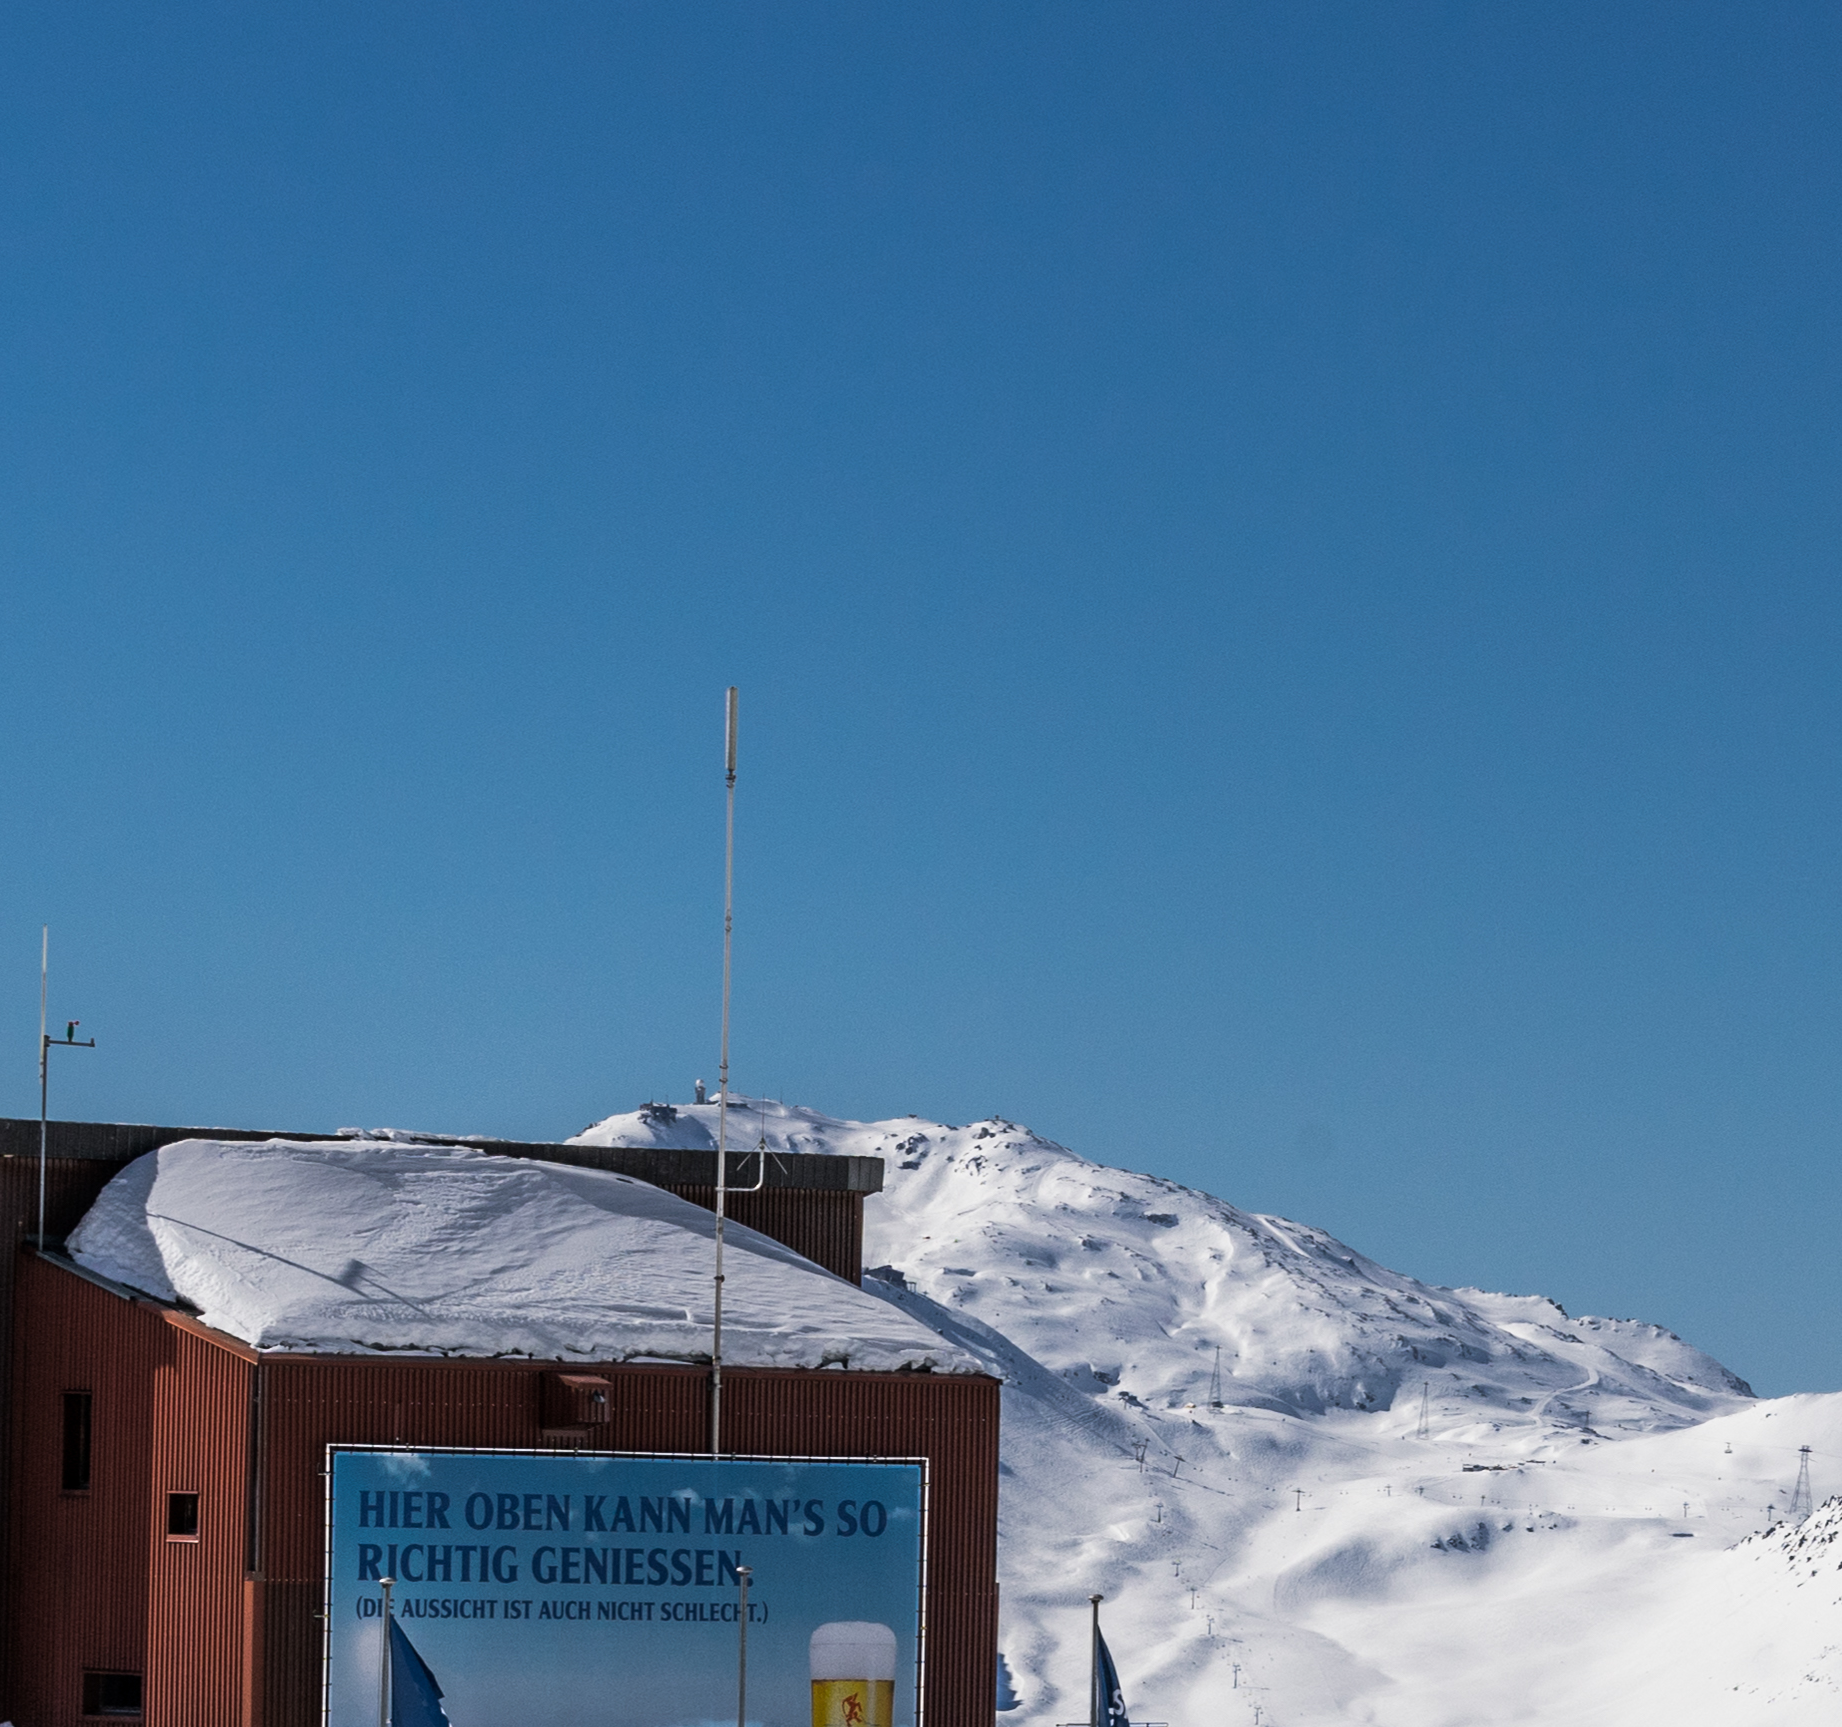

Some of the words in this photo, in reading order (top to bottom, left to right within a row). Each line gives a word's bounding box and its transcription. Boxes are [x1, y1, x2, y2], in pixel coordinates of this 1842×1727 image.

[358, 1489, 452, 1529] HIER
[464, 1491, 570, 1531] OBEN
[584, 1494, 692, 1534] KANN
[704, 1497, 825, 1537] MAN'S
[837, 1499, 888, 1538] SO
[357, 1543, 518, 1583] RICHTIG
[531, 1546, 754, 1587] GENIESSEN.
[401, 1598, 498, 1620] AUSSICHT
[503, 1600, 533, 1620] IST
[538, 1600, 591, 1621] AUCH
[597, 1601, 655, 1621] NICHT
